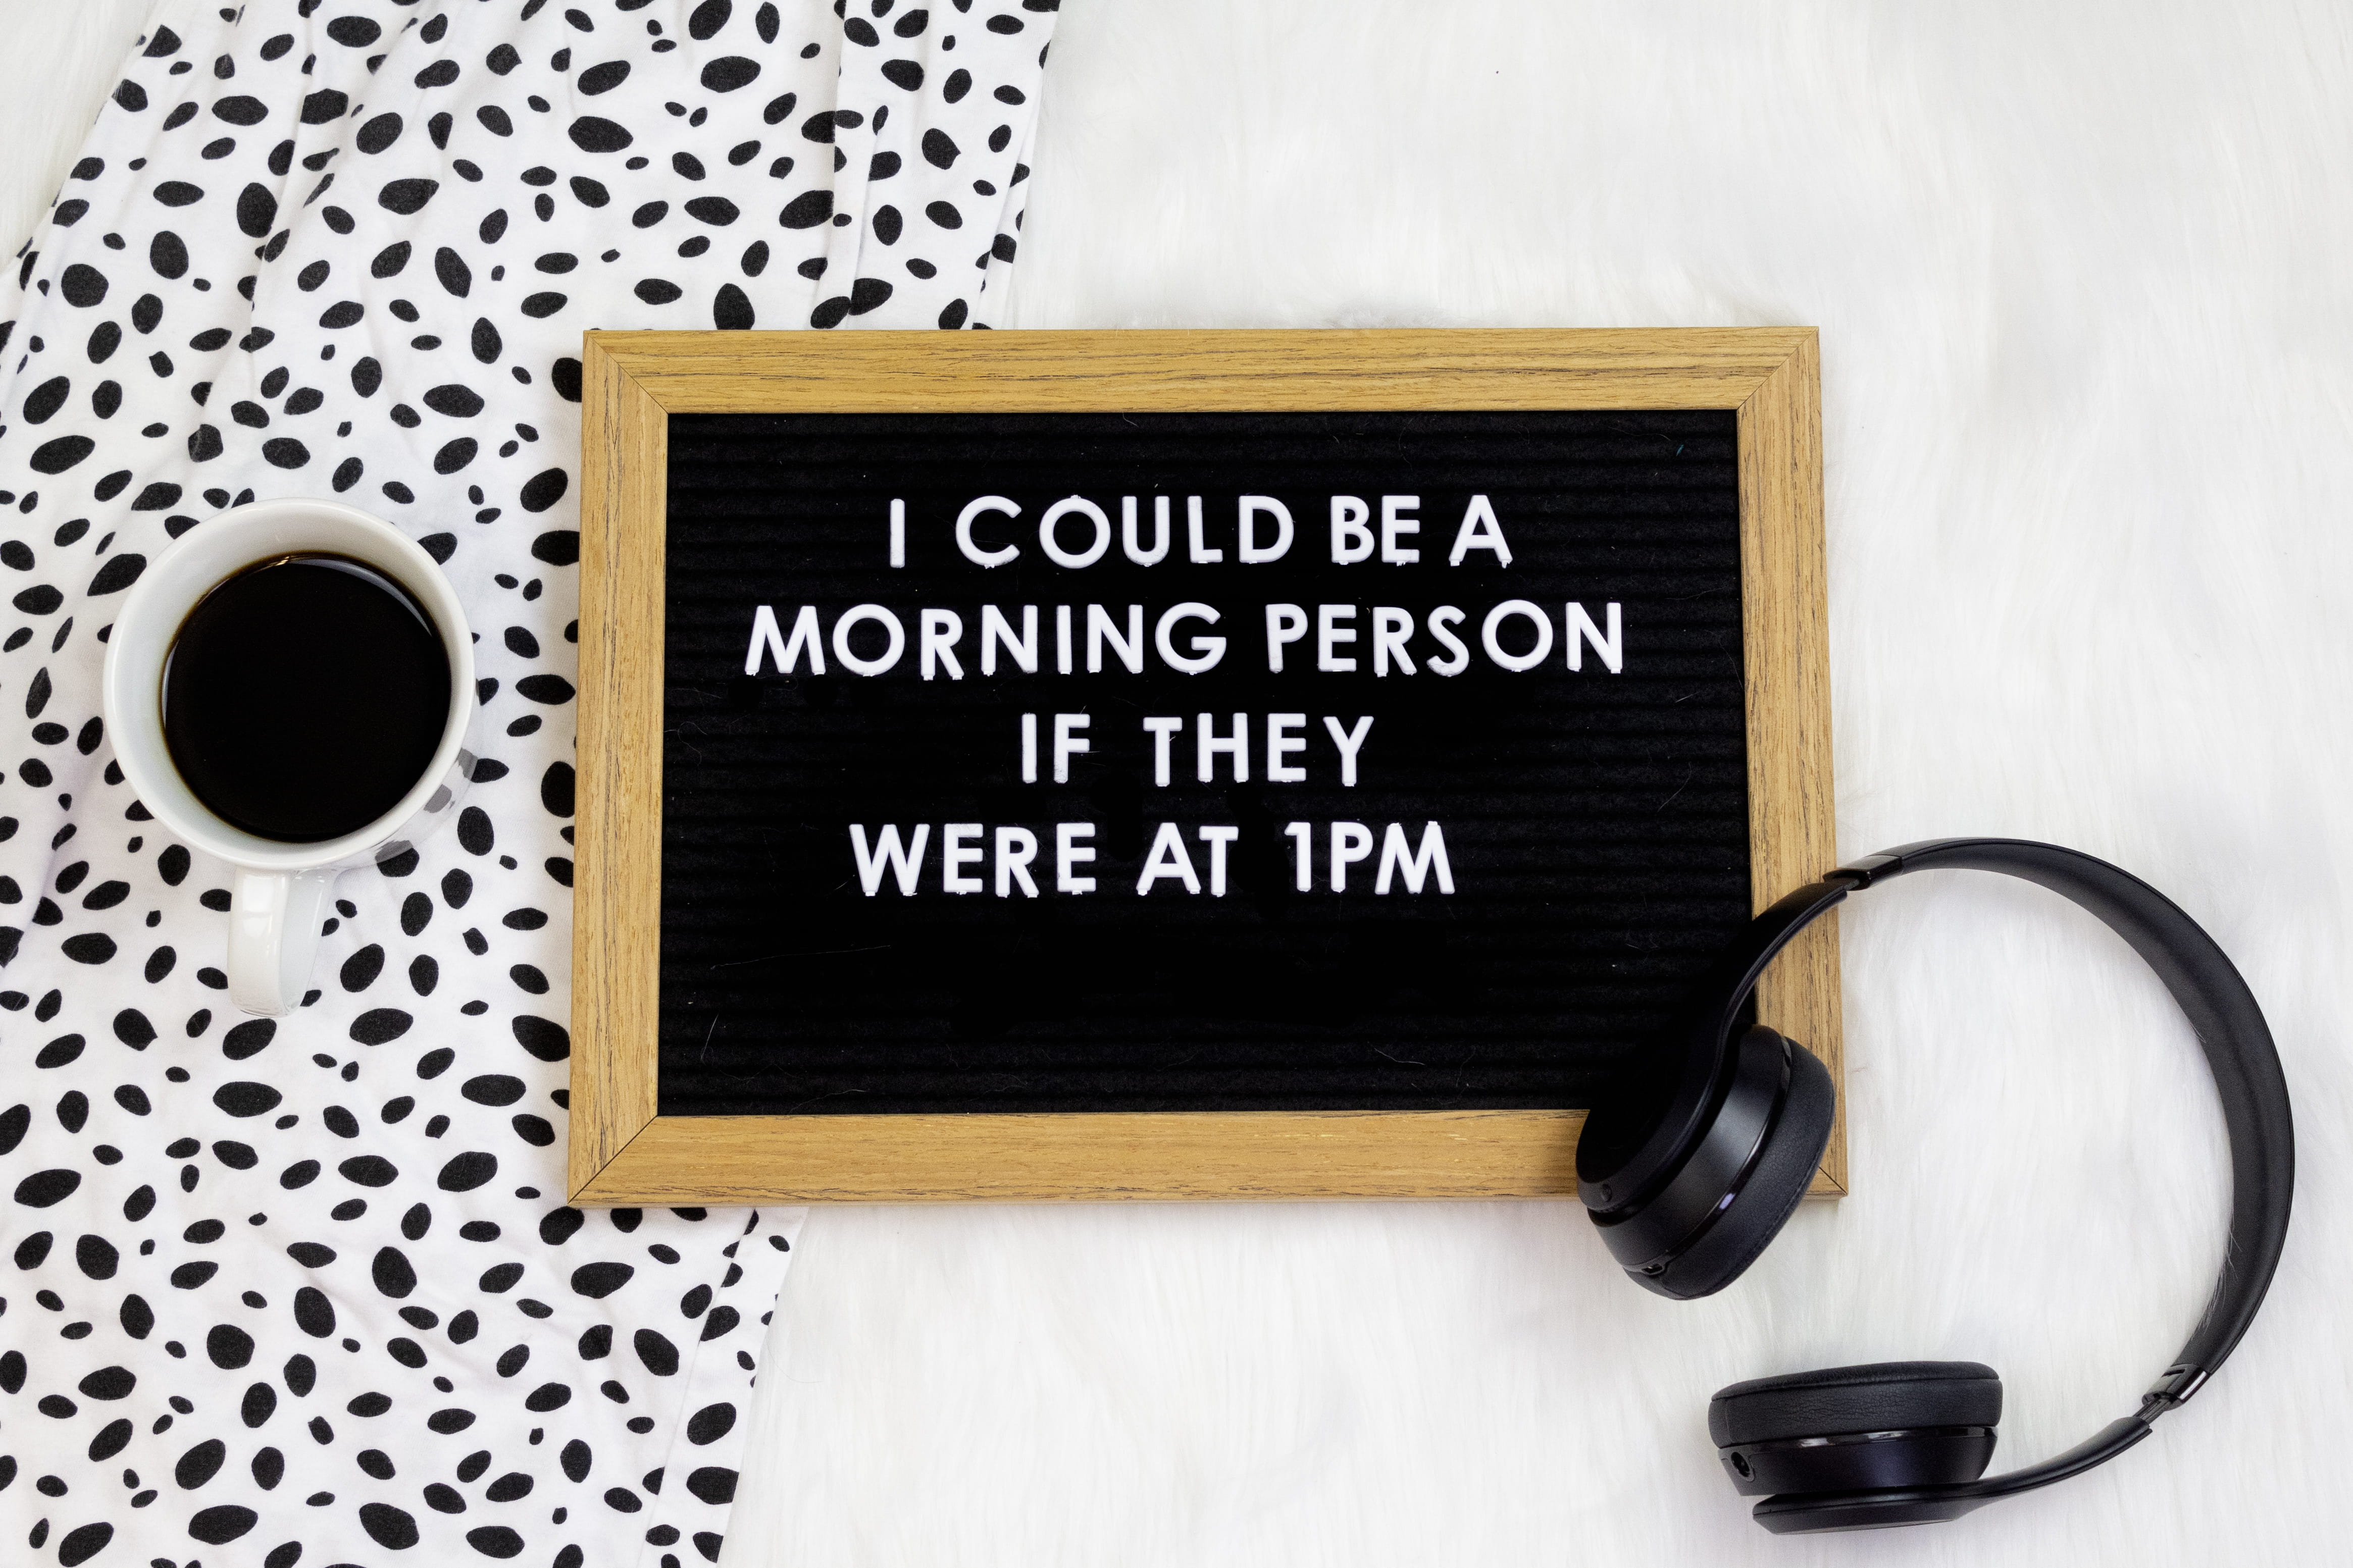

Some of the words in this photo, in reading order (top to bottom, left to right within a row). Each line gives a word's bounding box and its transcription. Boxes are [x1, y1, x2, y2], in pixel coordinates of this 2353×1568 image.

[890, 498, 905, 568] I
[955, 494, 1294, 569] COULD
[1331, 495, 1420, 566] BE
[1449, 495, 1513, 569] A
[744, 602, 1226, 681] MORNING
[1265, 599, 1623, 677] PERSON
[1021, 712, 1090, 784] IF
[1143, 712, 1374, 787] THEY
[849, 822, 1096, 898] WERE
[1136, 822, 1239, 898] AT
[1284, 820, 1455, 895] 1PM
